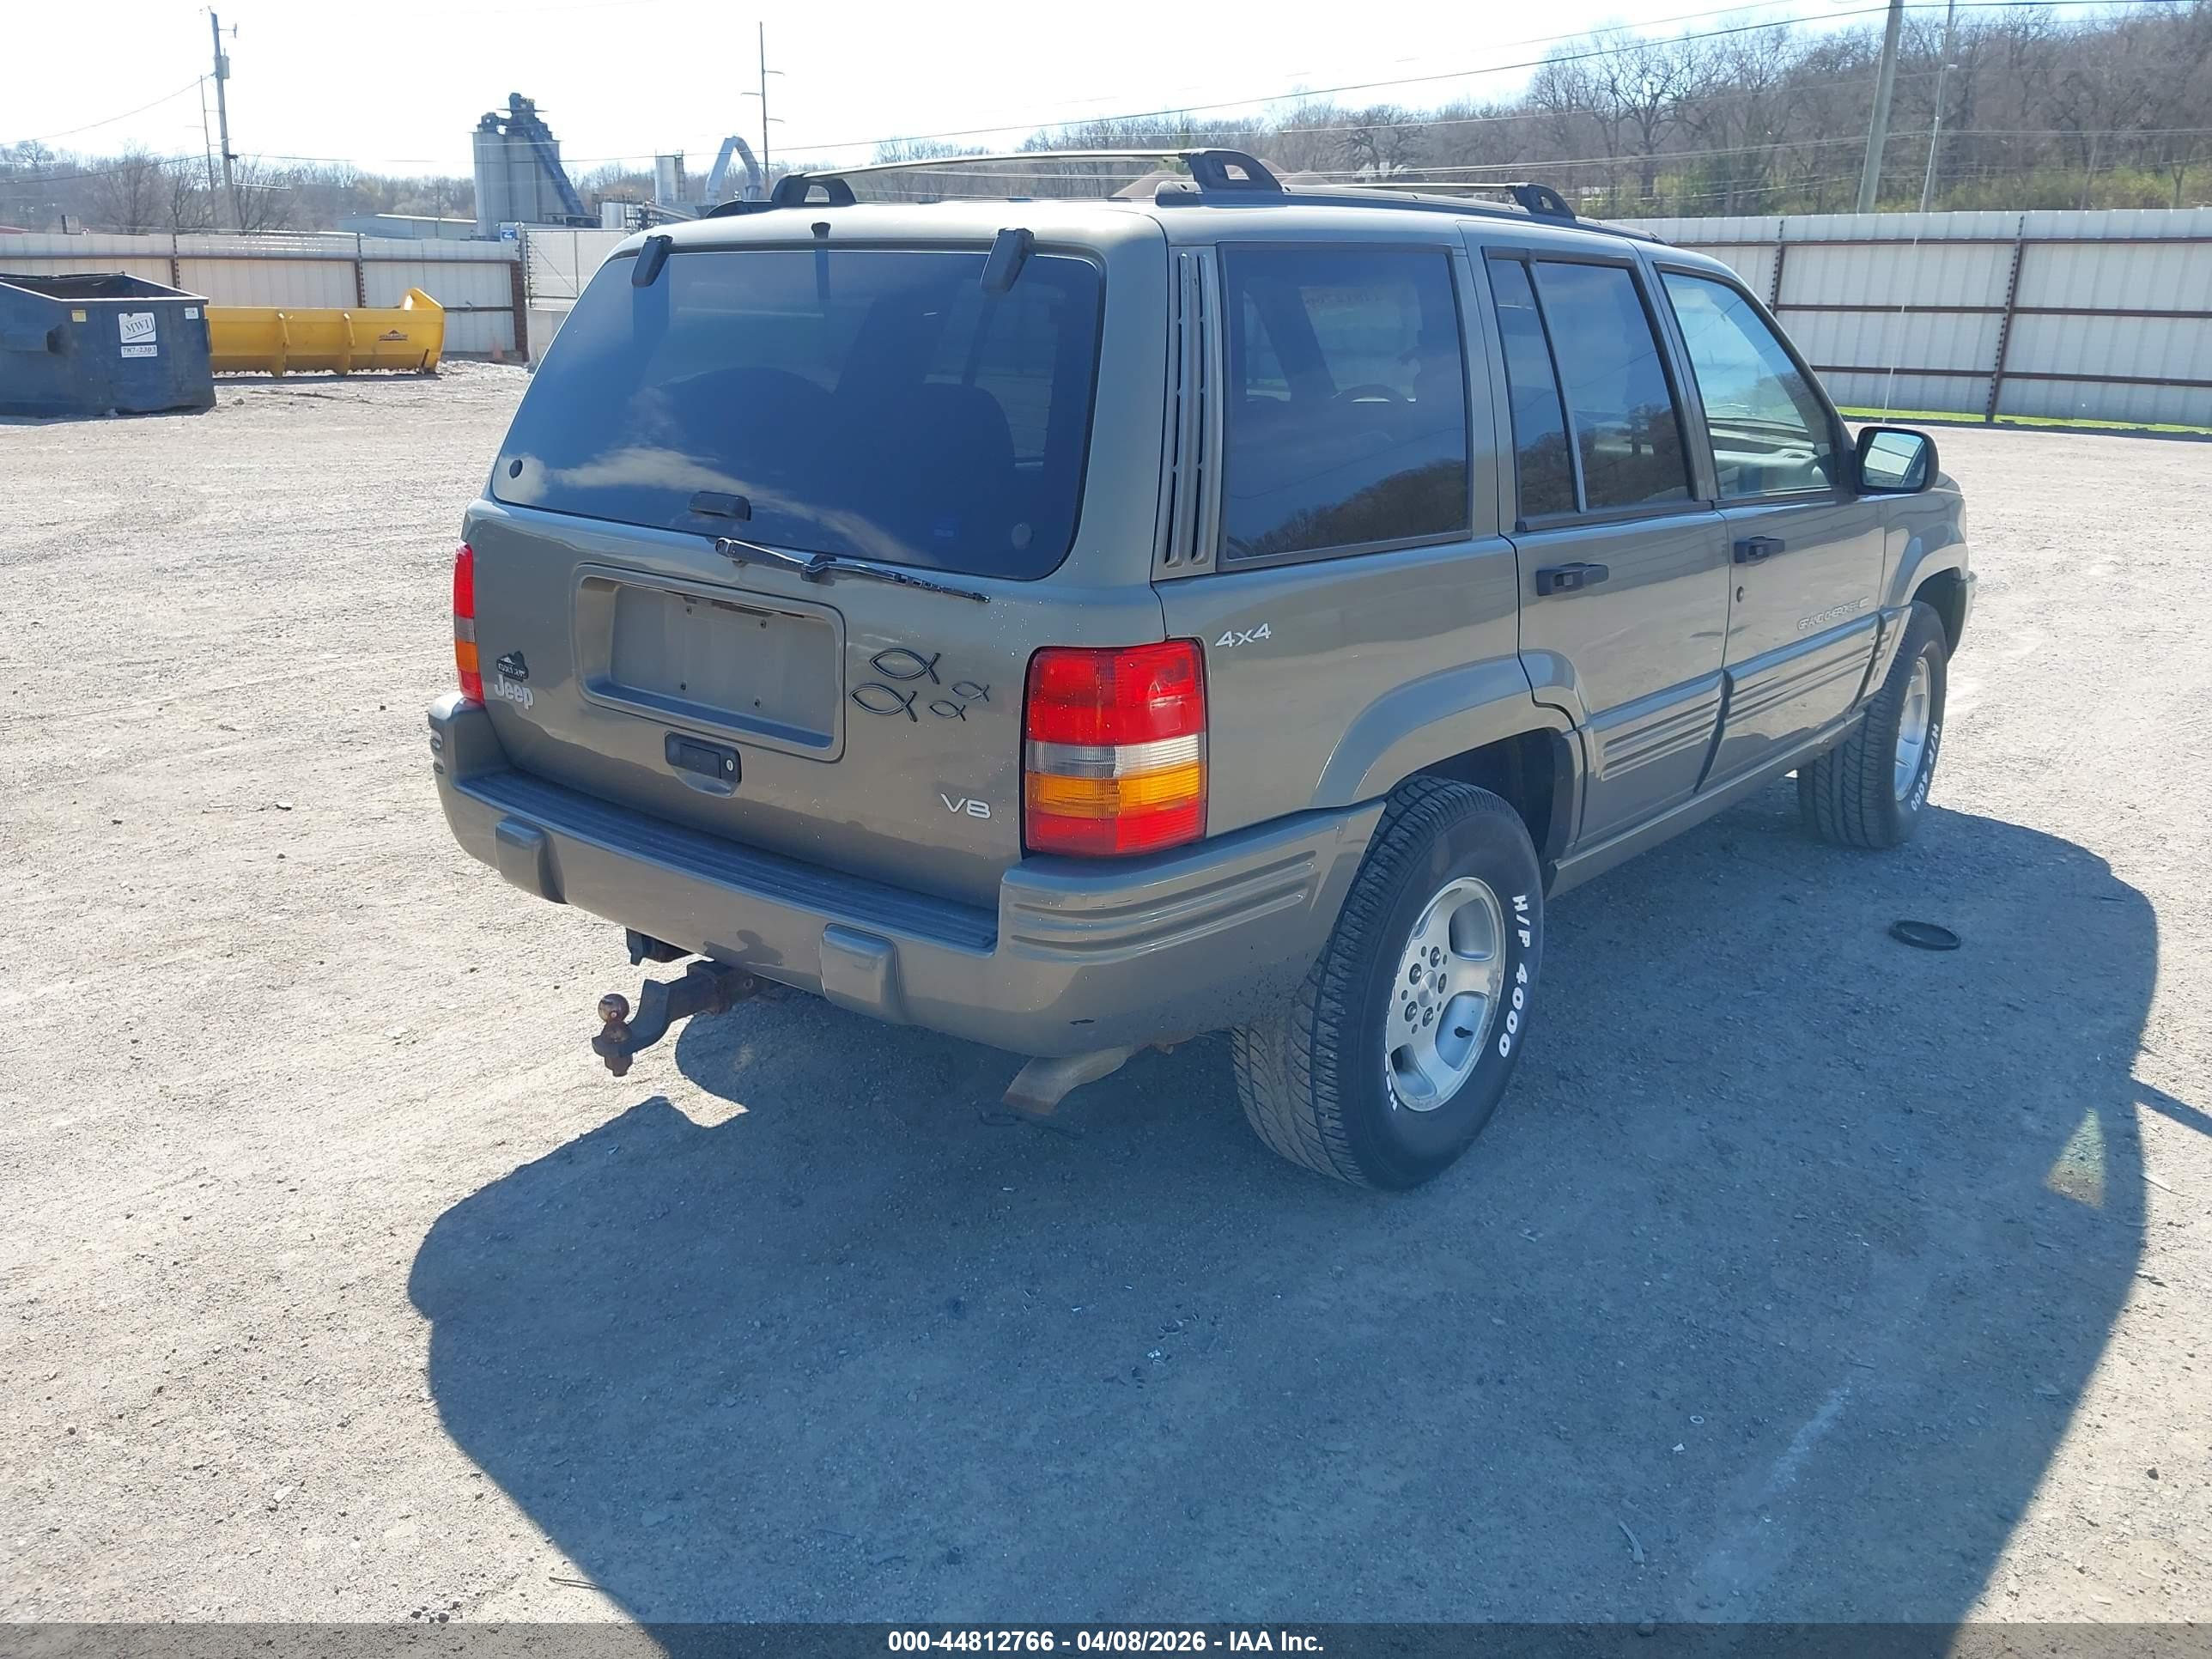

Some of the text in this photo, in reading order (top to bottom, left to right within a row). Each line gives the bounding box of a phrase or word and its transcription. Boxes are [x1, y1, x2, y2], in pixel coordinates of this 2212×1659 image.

[124, 317, 151, 335] MWI
[1215, 623, 1272, 647] 4x4
[494, 673, 534, 711] Jeep
[1911, 723, 1939, 811] H/P 4000
[940, 793, 991, 819] V8
[1498, 895, 1531, 1058] H/P 4000
